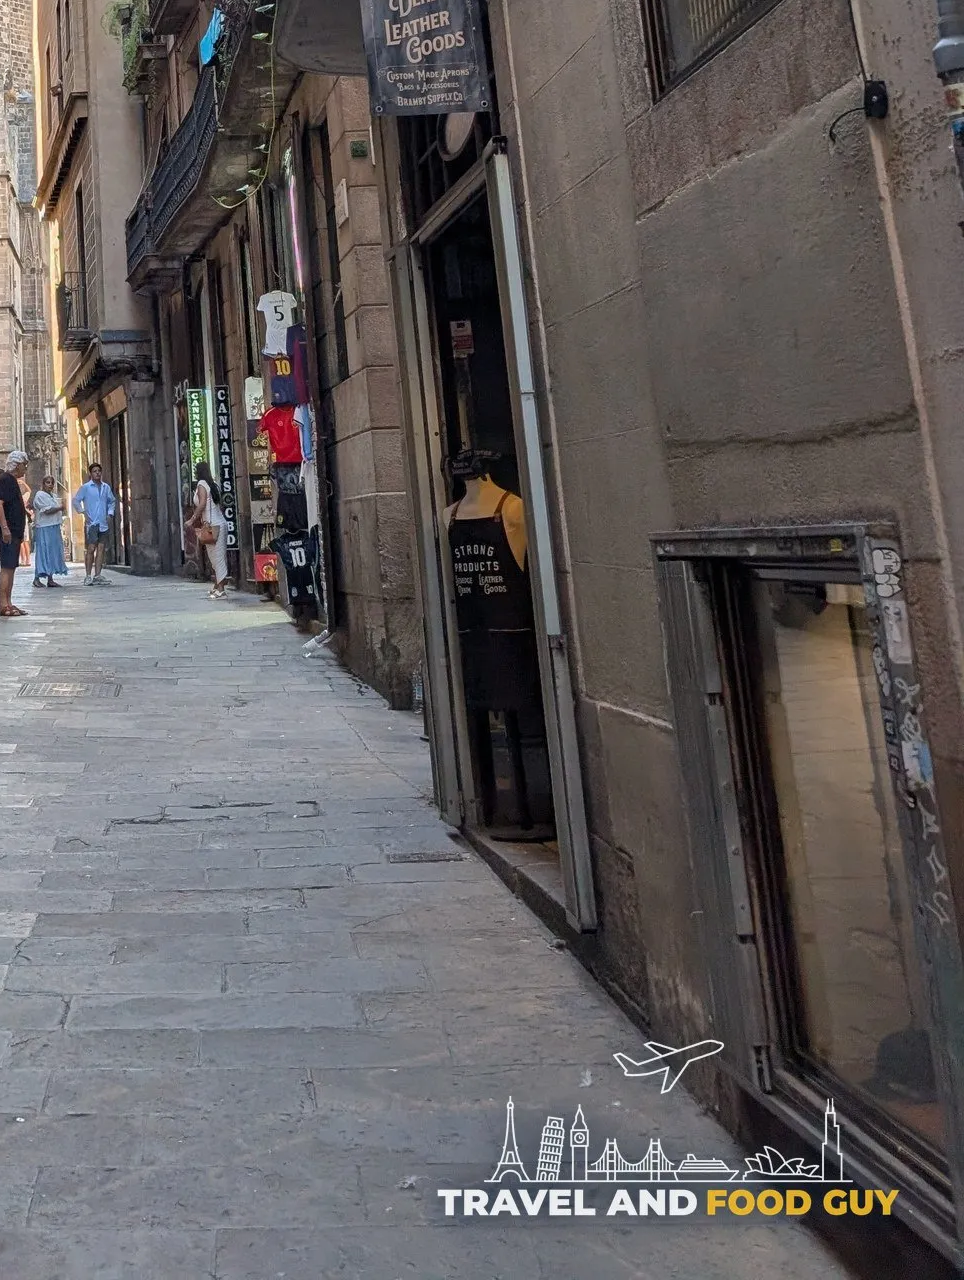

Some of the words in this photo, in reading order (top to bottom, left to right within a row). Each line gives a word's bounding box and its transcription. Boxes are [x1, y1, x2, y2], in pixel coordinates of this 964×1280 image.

[384, 10, 450, 46] LEATHER
[406, 31, 466, 63] GOODS
[387, 71, 414, 82] CUSTOM
[416, 70, 439, 81] MADE
[439, 68, 469, 81] APRONS
[397, 82, 414, 91] BAGS
[421, 82, 459, 93] ACCESSORIES
[427, 92, 452, 104] SUPPLY
[273, 305, 284, 321] 5
[275, 360, 291, 375] 10
[190, 393, 202, 449] CANNABIS
[217, 389, 231, 492] CANNABIS
[225, 507, 236, 545] CBD
[288, 547, 306, 567] 10
[454, 544, 494, 558] STRONG
[454, 561, 499, 572] PRODUCTS
[478, 574, 503, 585] LEATHER
[484, 584, 506, 594] GOODS
